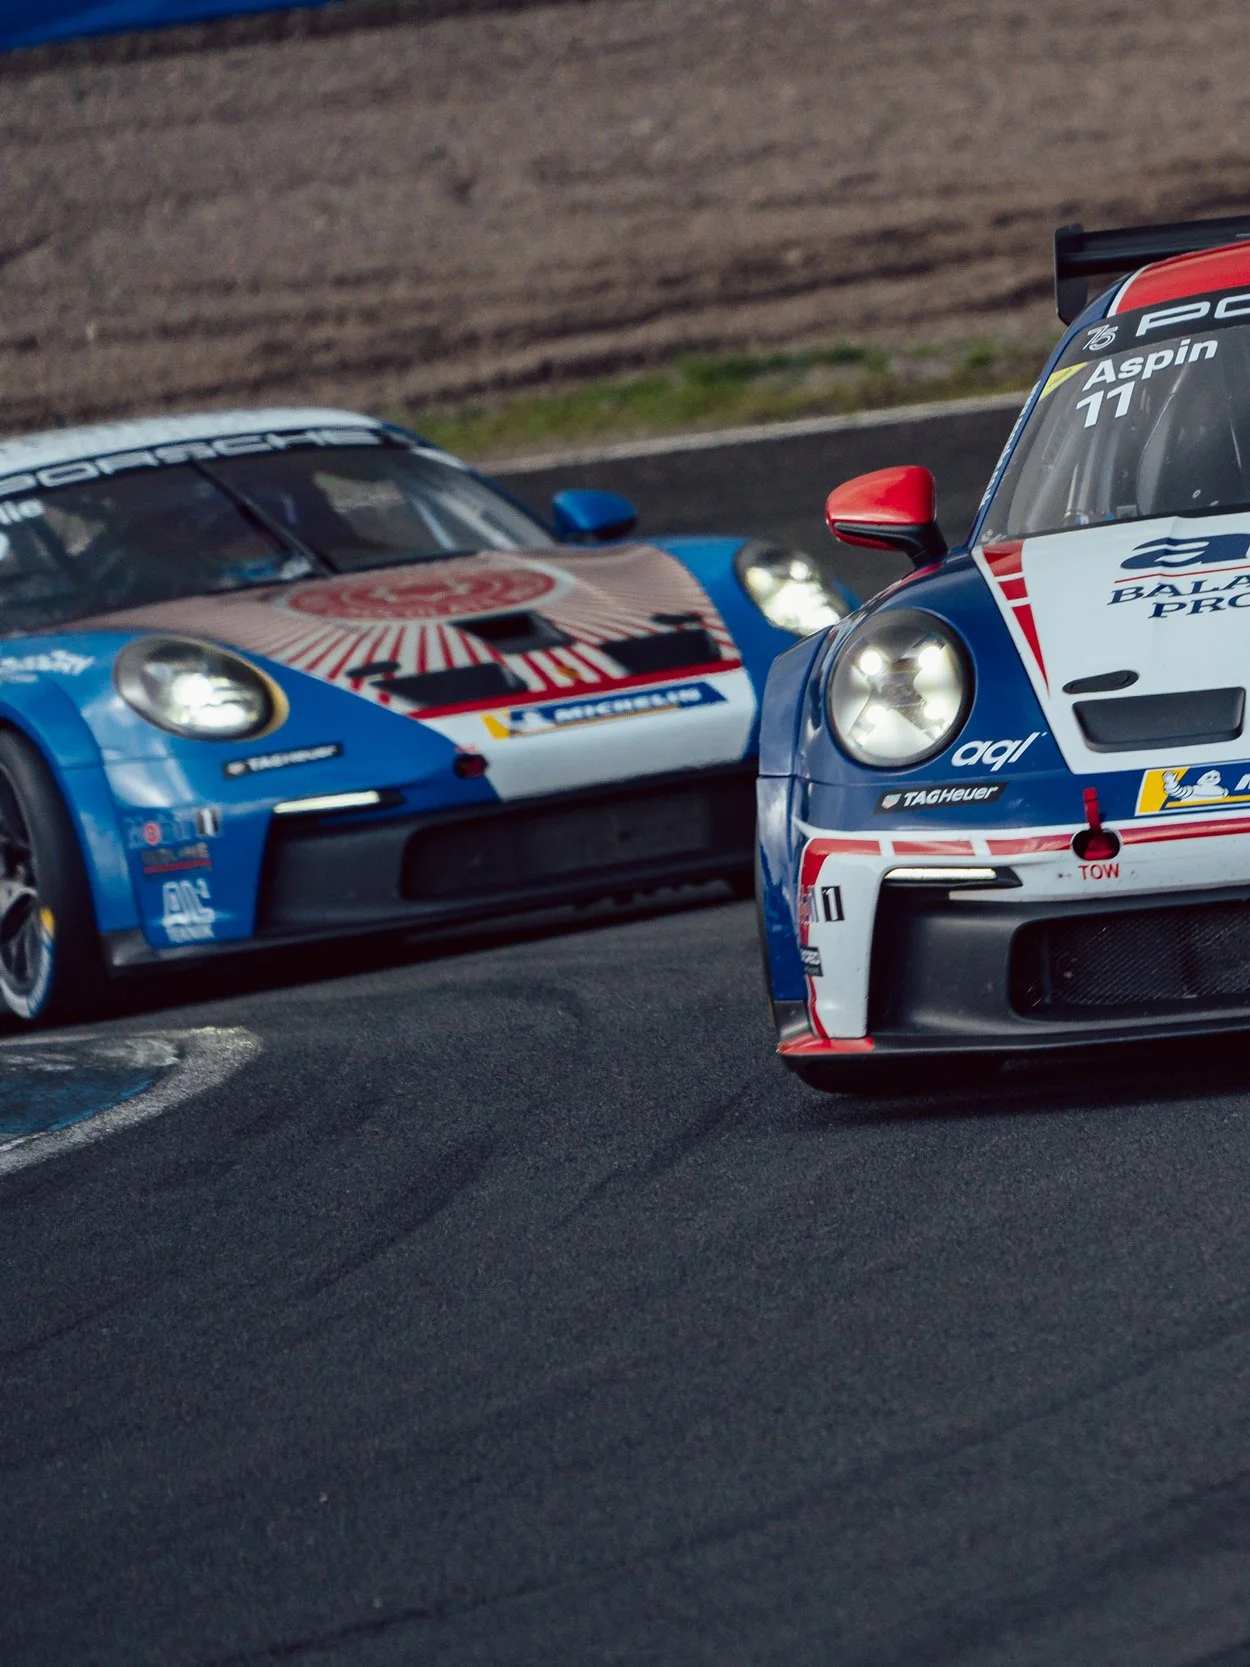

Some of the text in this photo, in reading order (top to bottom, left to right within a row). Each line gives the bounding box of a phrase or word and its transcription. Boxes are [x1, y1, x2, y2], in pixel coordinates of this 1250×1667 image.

[1081, 338, 1219, 391] Aspin
[1076, 381, 1136, 429] 11
[553, 688, 701, 723] MICHELIN
[950, 731, 1047, 772] aql
[1078, 864, 1120, 880] TOW
